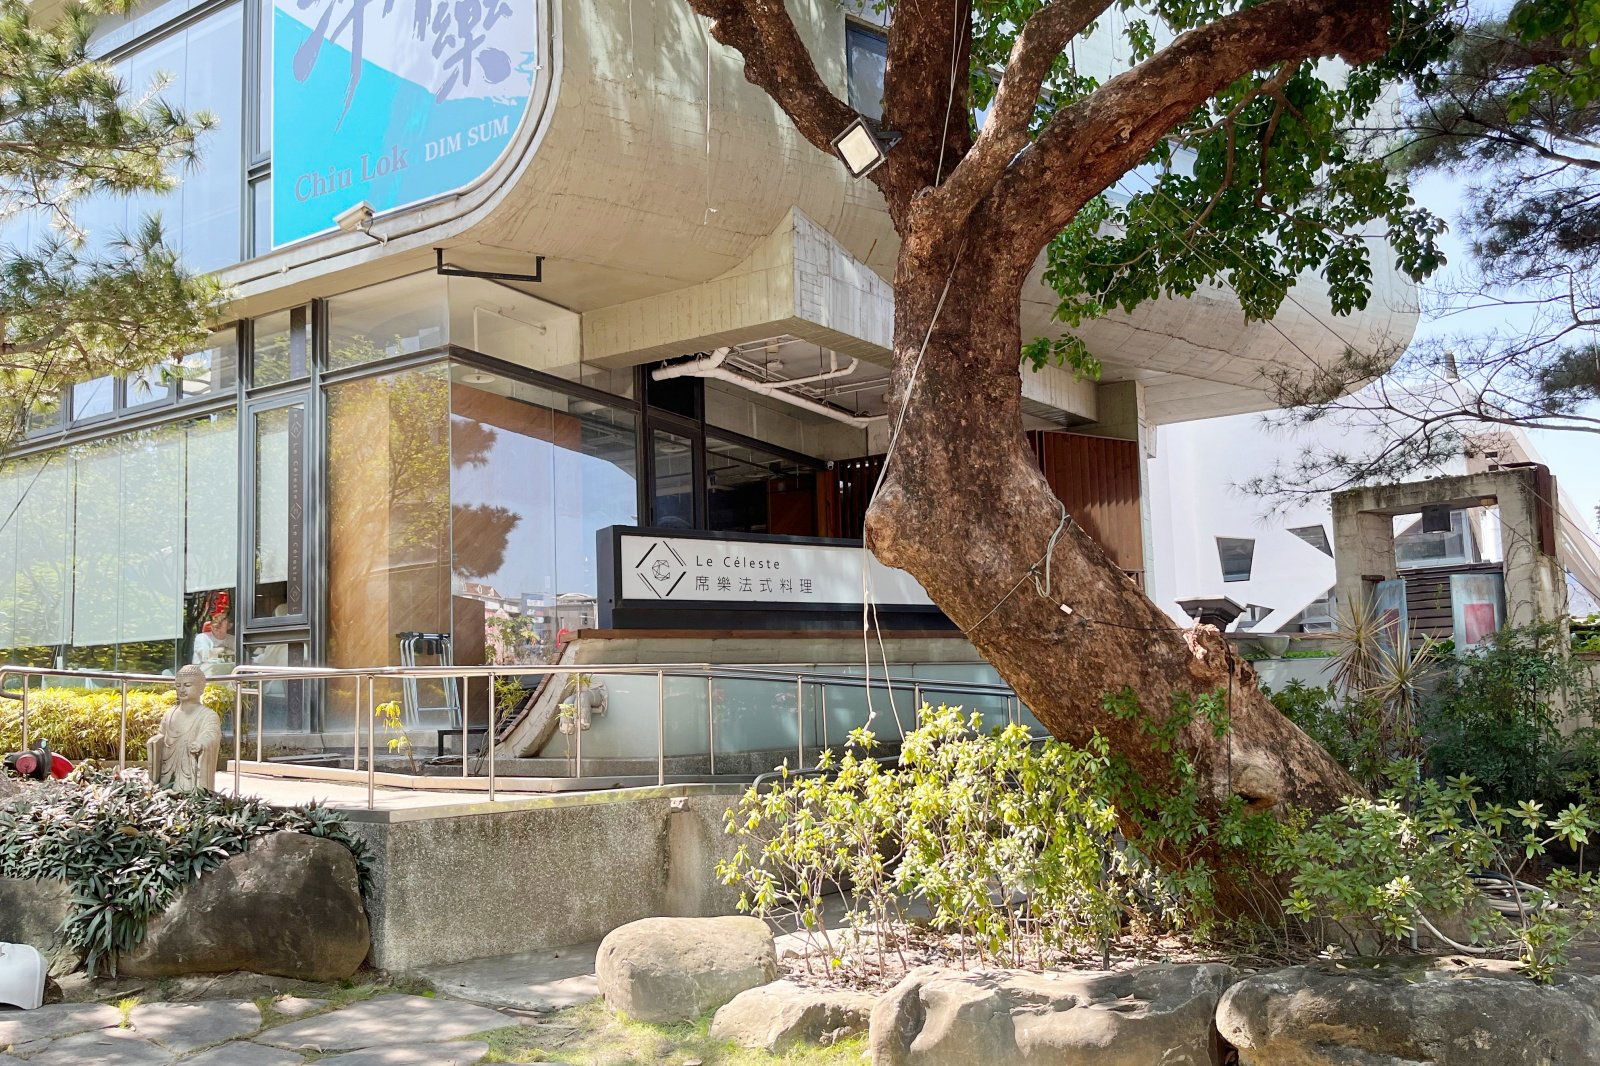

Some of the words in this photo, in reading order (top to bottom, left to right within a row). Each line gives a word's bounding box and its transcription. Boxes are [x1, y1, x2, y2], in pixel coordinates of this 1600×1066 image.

[295, 167, 352, 202] Chiu
[360, 145, 409, 181] Lok
[425, 132, 462, 162] DIM
[467, 115, 510, 148] SUM
[696, 555, 713, 567] Le
[723, 556, 780, 570] Céleste
[695, 576, 813, 594] 席樂法式料理
